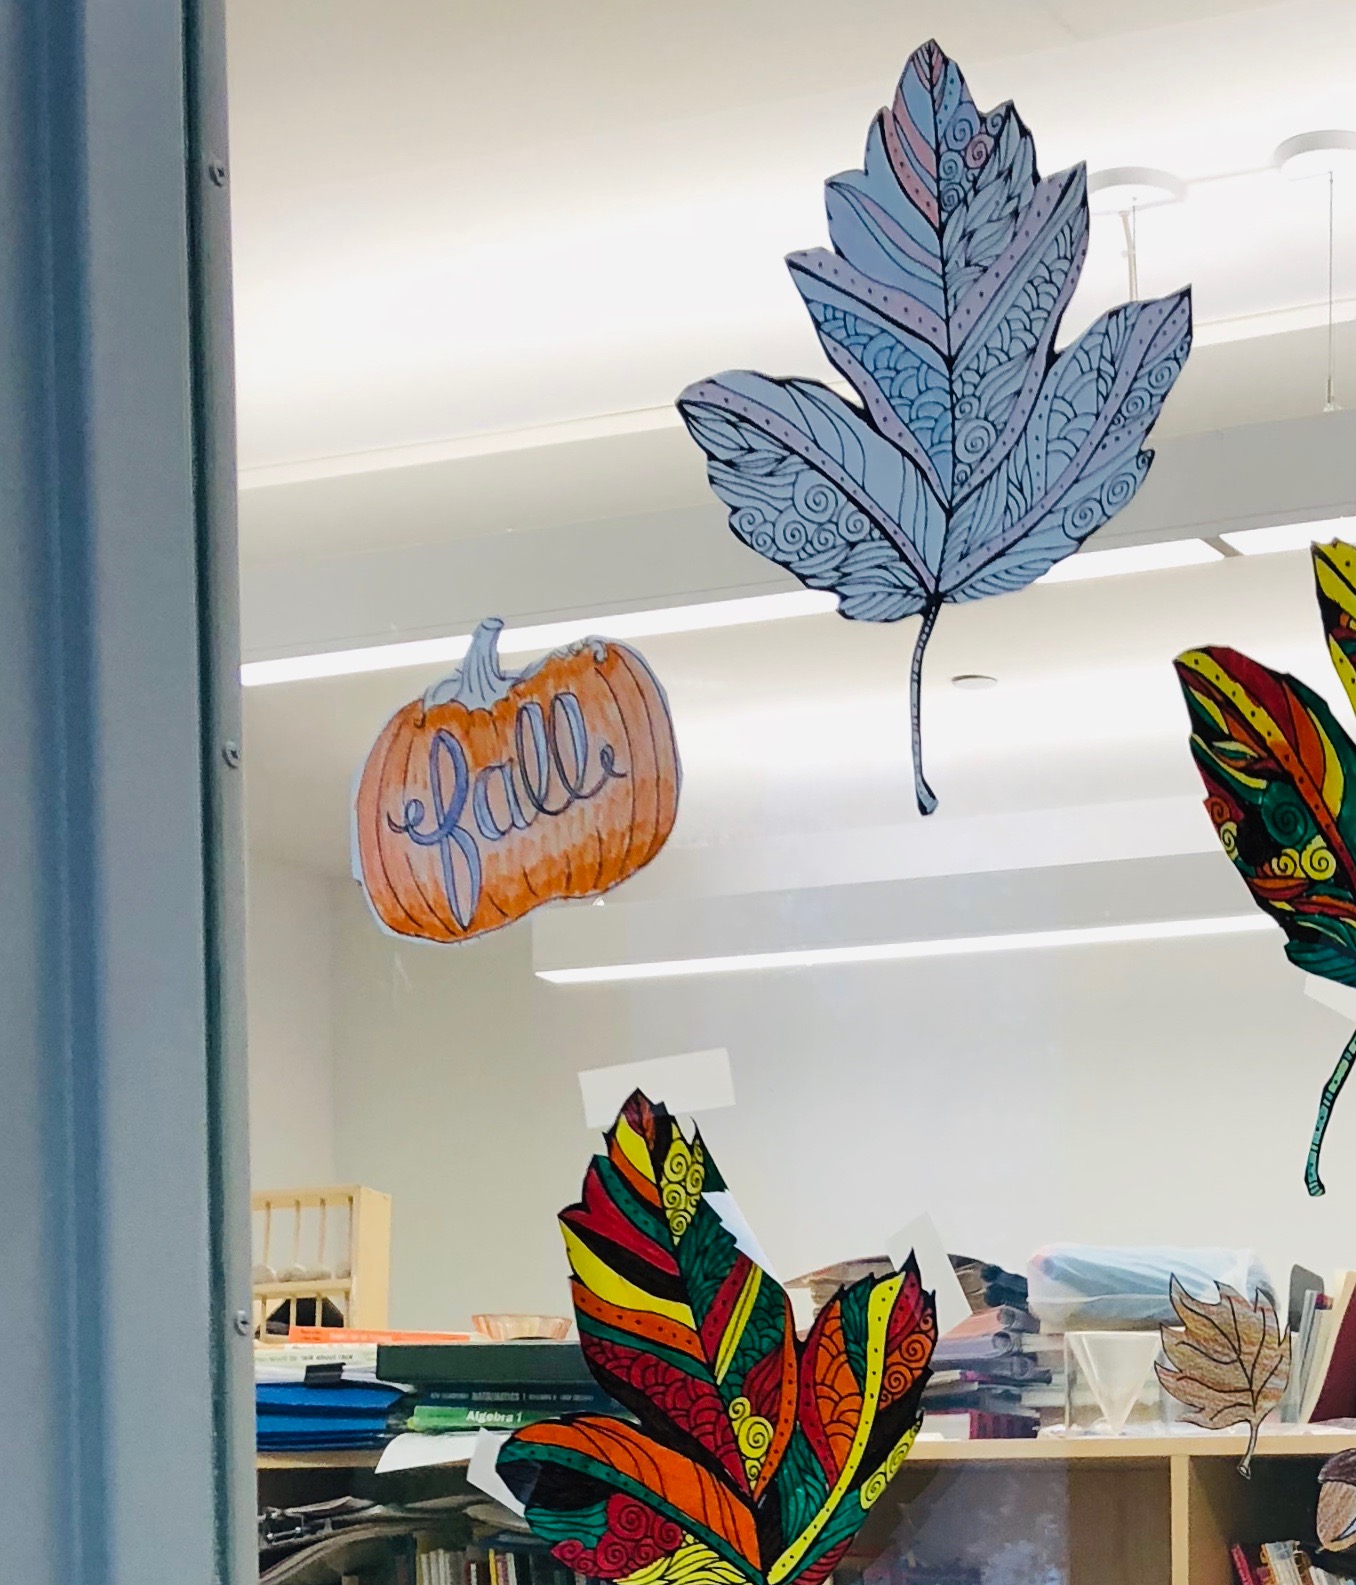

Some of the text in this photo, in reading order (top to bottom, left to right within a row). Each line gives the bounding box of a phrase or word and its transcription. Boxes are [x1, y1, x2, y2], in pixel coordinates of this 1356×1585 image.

[387, 691, 626, 929] fall
[466, 1410, 522, 1424] Algebra 1
